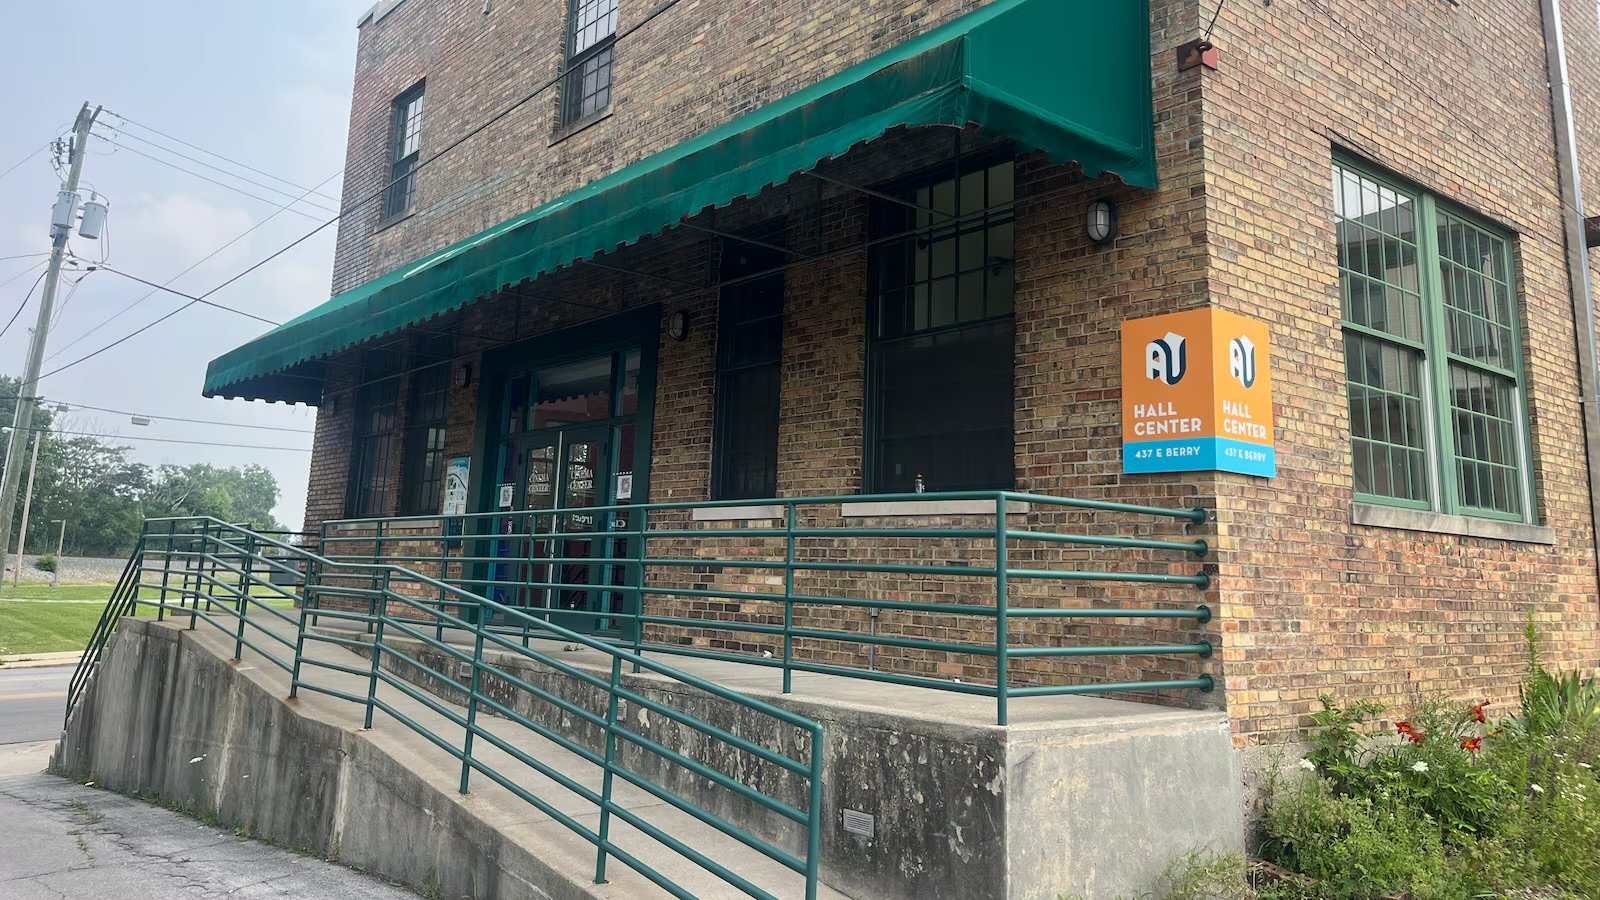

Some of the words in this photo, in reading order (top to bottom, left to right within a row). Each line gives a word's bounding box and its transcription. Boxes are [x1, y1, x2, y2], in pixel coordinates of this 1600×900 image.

[1134, 402, 1177, 418] HALL
[1223, 400, 1251, 419] HALL
[1134, 418, 1201, 436] CENTER
[1223, 418, 1266, 439] CENTER
[1135, 450, 1152, 458] 437
[1156, 449, 1162, 457] E
[1166, 446, 1200, 457] BERRY
[1225, 448, 1237, 457] 437
[1238, 449, 1243, 458] E
[1244, 450, 1266, 462] BERRY
[570, 469, 593, 480] CINEMA
[528, 483, 549, 493] CENTER
[570, 480, 592, 491] CENTER
